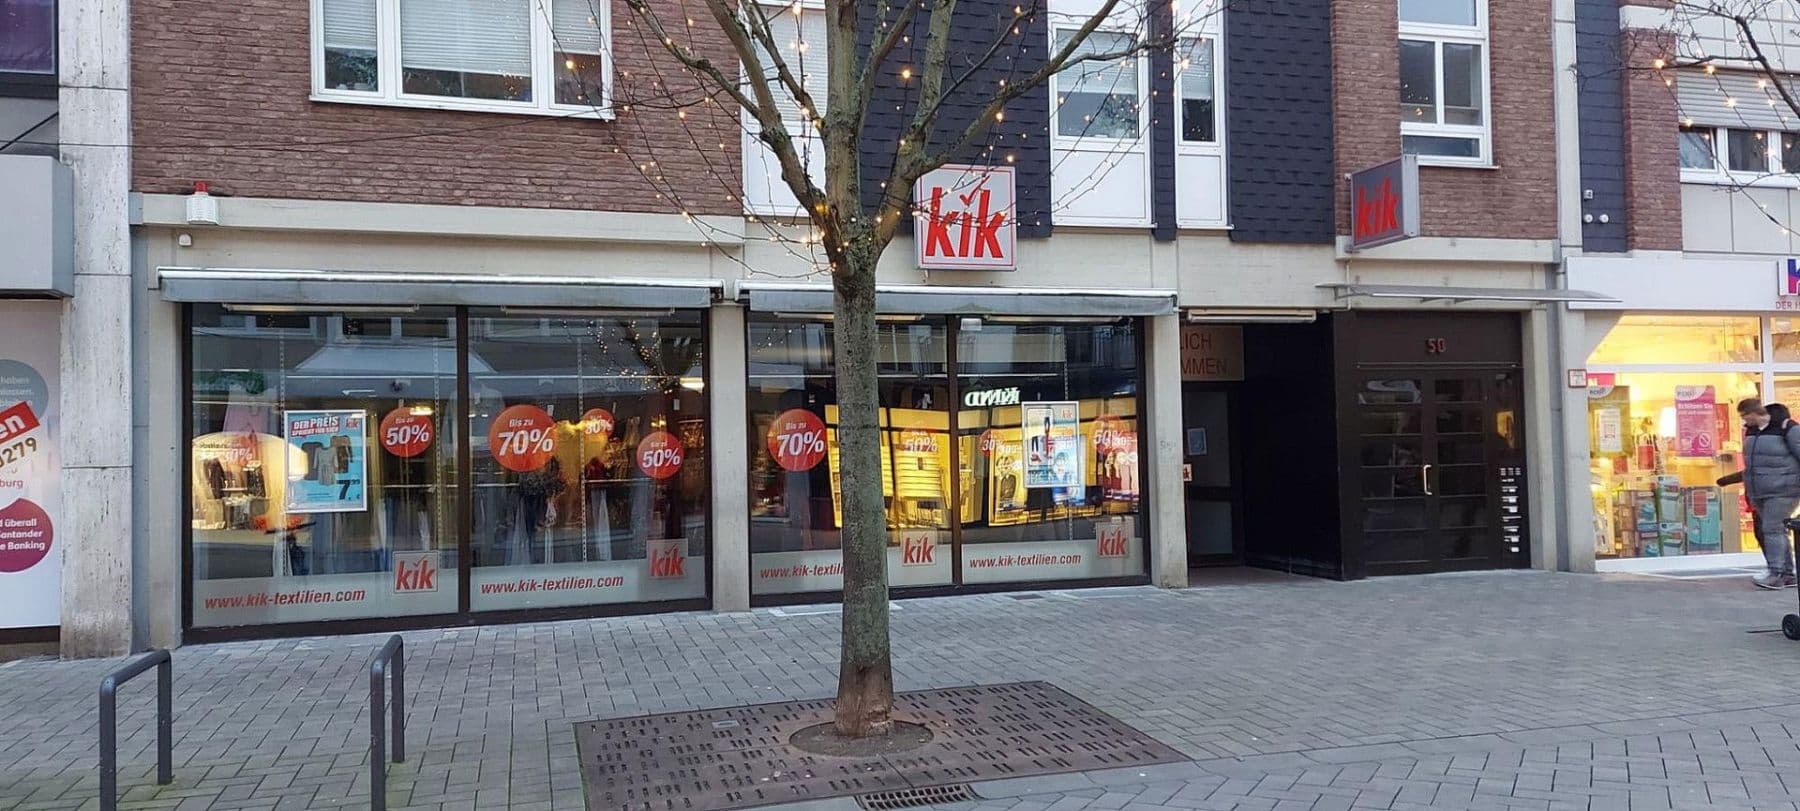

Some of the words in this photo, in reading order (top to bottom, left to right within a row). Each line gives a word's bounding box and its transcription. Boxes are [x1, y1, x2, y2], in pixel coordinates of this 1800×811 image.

[925, 175, 1007, 258] kik
[1355, 176, 1399, 241] kik
[1776, 301, 1792, 310] DER
[1180, 333, 1211, 350] ICH
[1428, 337, 1447, 352] 50
[294, 421, 309, 430] DER
[310, 416, 339, 428] PREIS
[509, 419, 522, 428] Bis
[386, 424, 430, 446] 50%
[498, 427, 554, 457] 70%
[777, 430, 825, 457] 70%
[642, 447, 681, 468] 50%
[5, 518, 37, 529] überall
[8, 541, 46, 551] Banking
[904, 532, 935, 564] kik
[1100, 528, 1127, 556] kik
[650, 543, 687, 577] kik
[969, 553, 1082, 568] www.kik-textilien.com
[396, 554, 436, 590] kik
[481, 575, 625, 594] www.kik-textilien.com
[205, 589, 366, 610] www.kik-textilien.com
